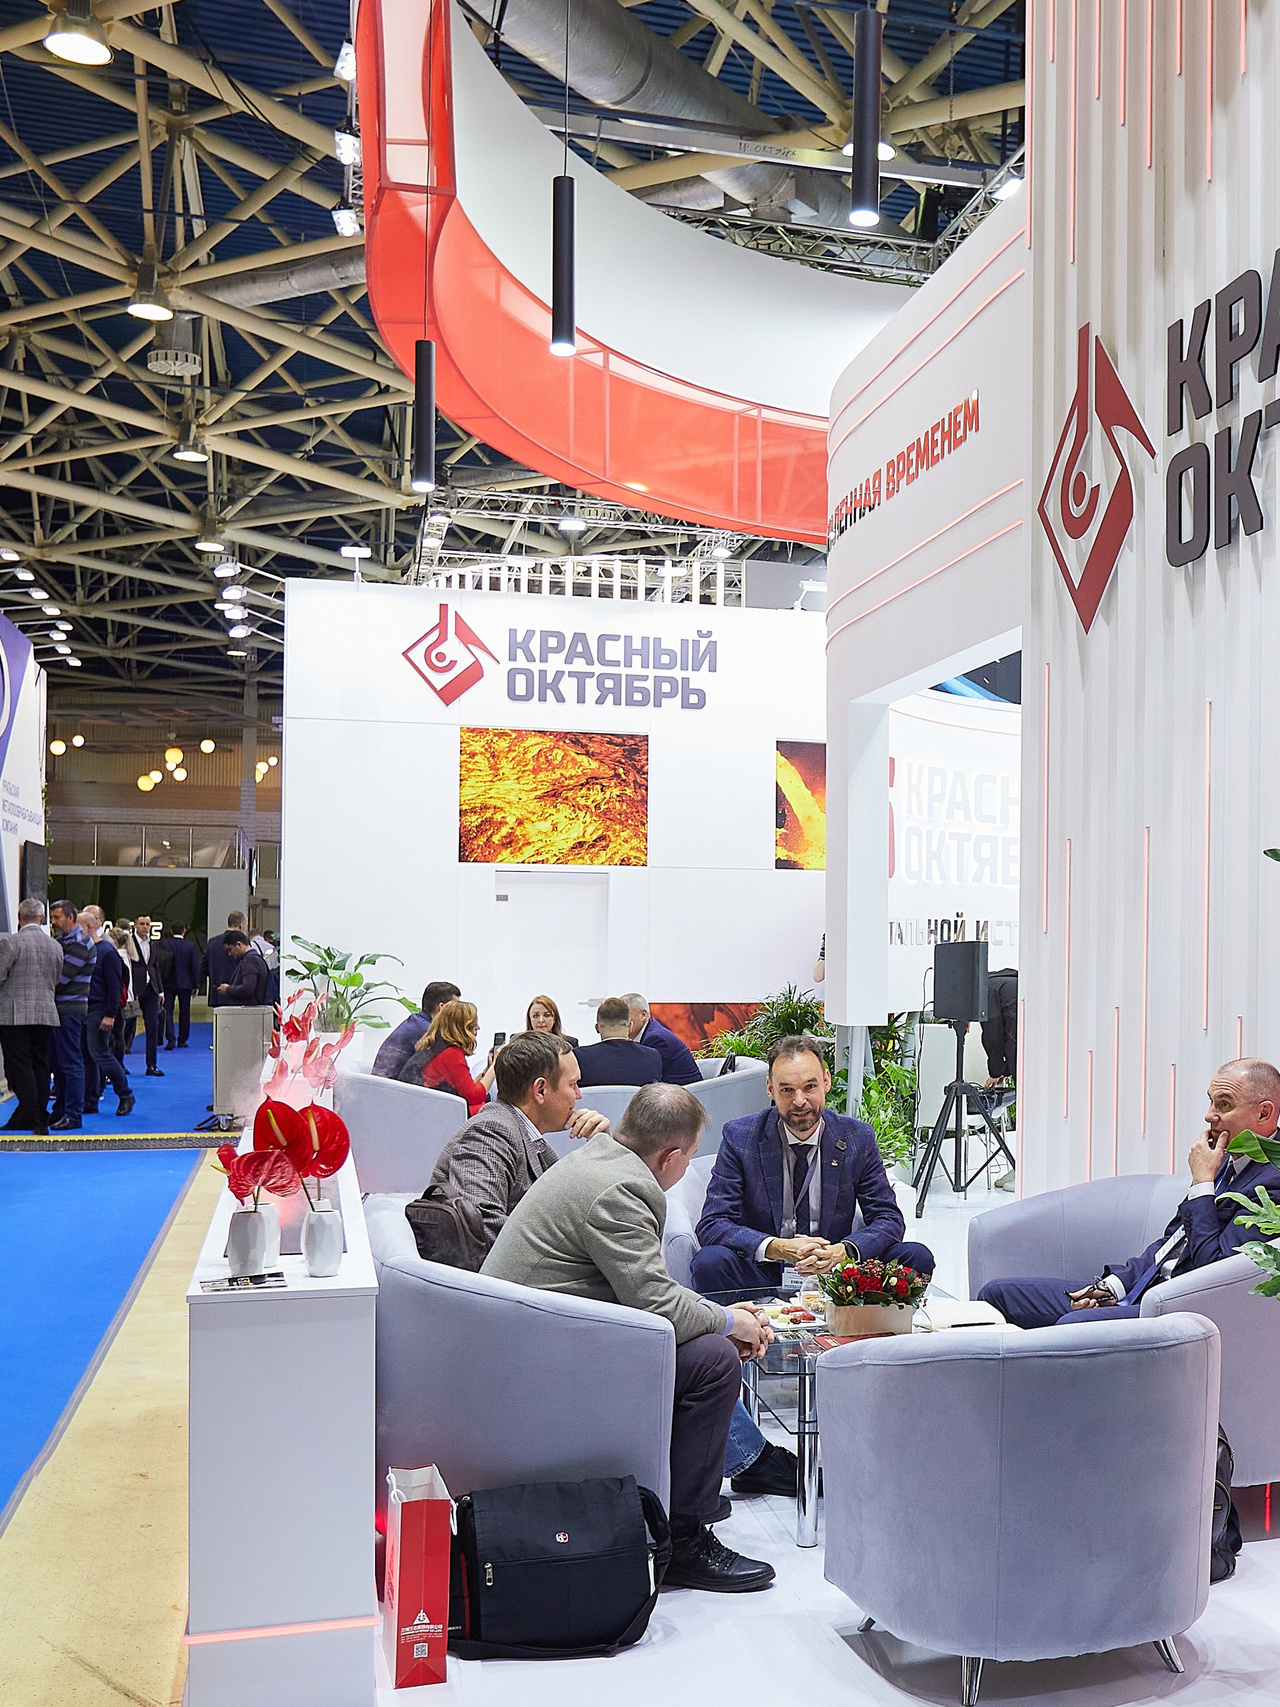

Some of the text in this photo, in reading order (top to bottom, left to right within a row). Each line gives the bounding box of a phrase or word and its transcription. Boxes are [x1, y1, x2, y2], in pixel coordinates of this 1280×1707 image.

[886, 389, 980, 501] ВРЕМЕНЕМ
[508, 628, 718, 673] КРАСНЫЙ
[507, 667, 707, 710] ОКТЯБРЬ
